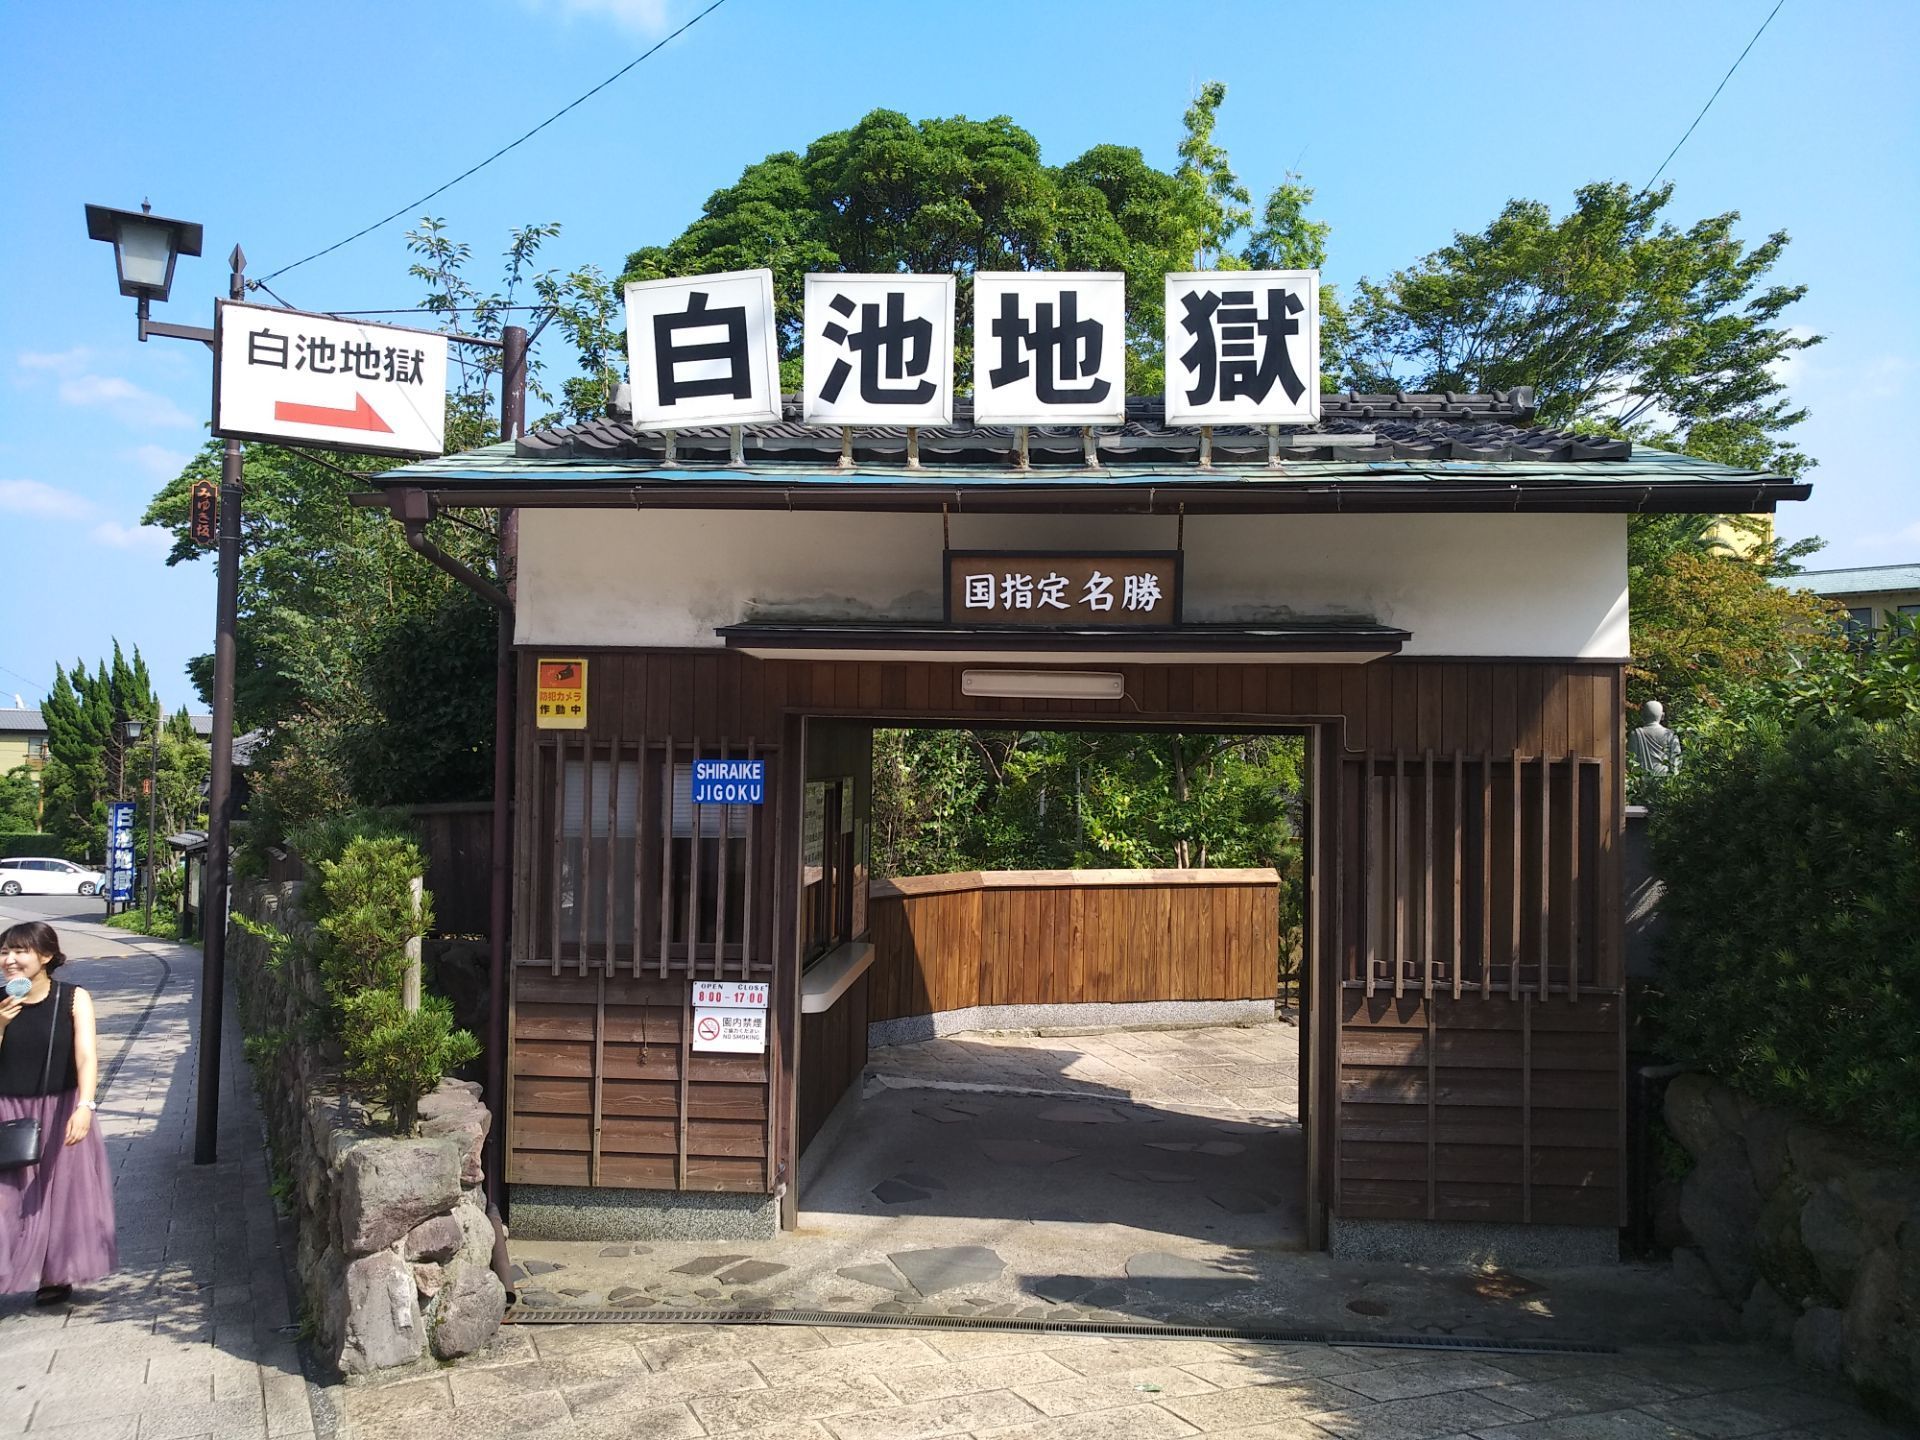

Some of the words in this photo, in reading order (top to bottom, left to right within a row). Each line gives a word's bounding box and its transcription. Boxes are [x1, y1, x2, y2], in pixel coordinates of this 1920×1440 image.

[652, 288, 1307, 407] 白池地獄
[248, 327, 425, 386] 白池地獄
[540, 691, 582, 702] 防犯カメラ
[540, 704, 582, 715] 作動中
[696, 763, 761, 780] SHIRAIKE
[696, 784, 761, 801] JIGOKU
